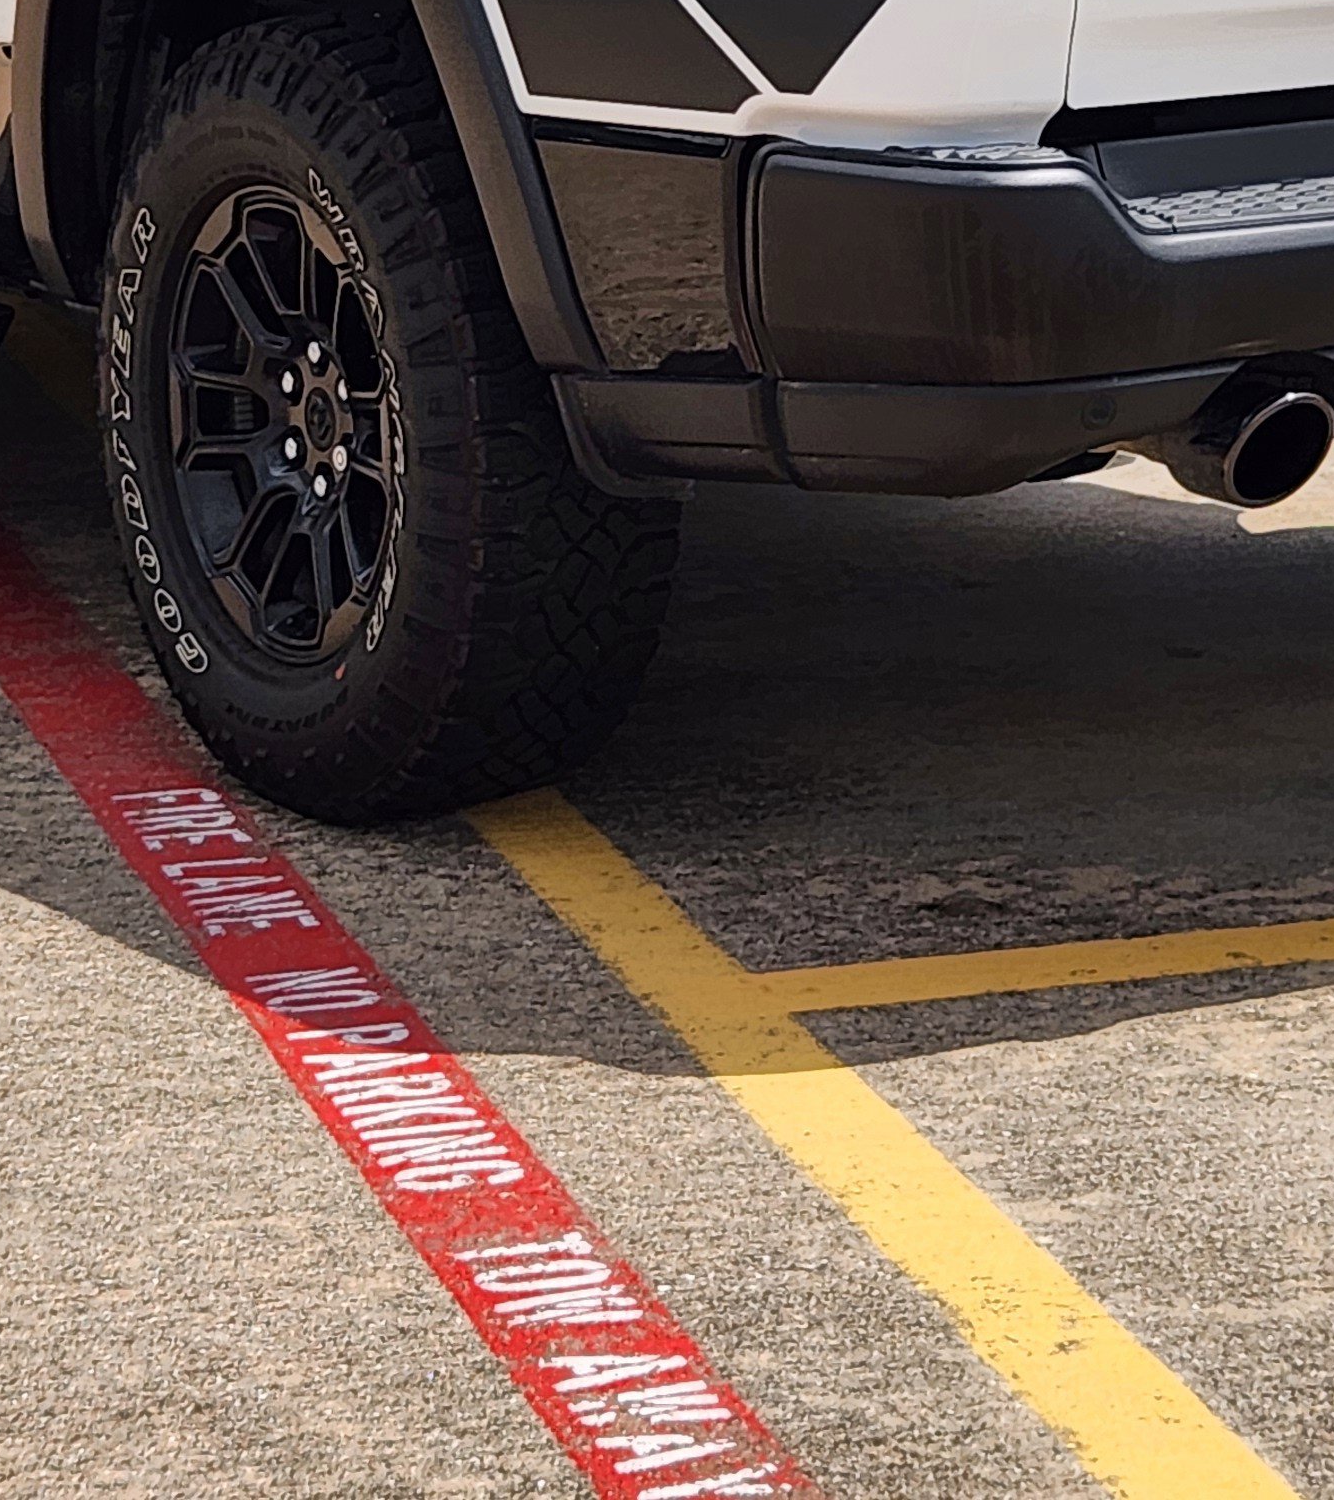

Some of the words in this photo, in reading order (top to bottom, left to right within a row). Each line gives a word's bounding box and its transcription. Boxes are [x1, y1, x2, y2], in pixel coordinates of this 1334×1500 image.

[110, 207, 209, 674] GOODYEAR
[110, 787, 254, 851] FIRE
[161, 856, 321, 937] LANE
[244, 965, 382, 1014] NO
[284, 1021, 525, 1192] PARKING
[453, 1231, 644, 1328] TOW
